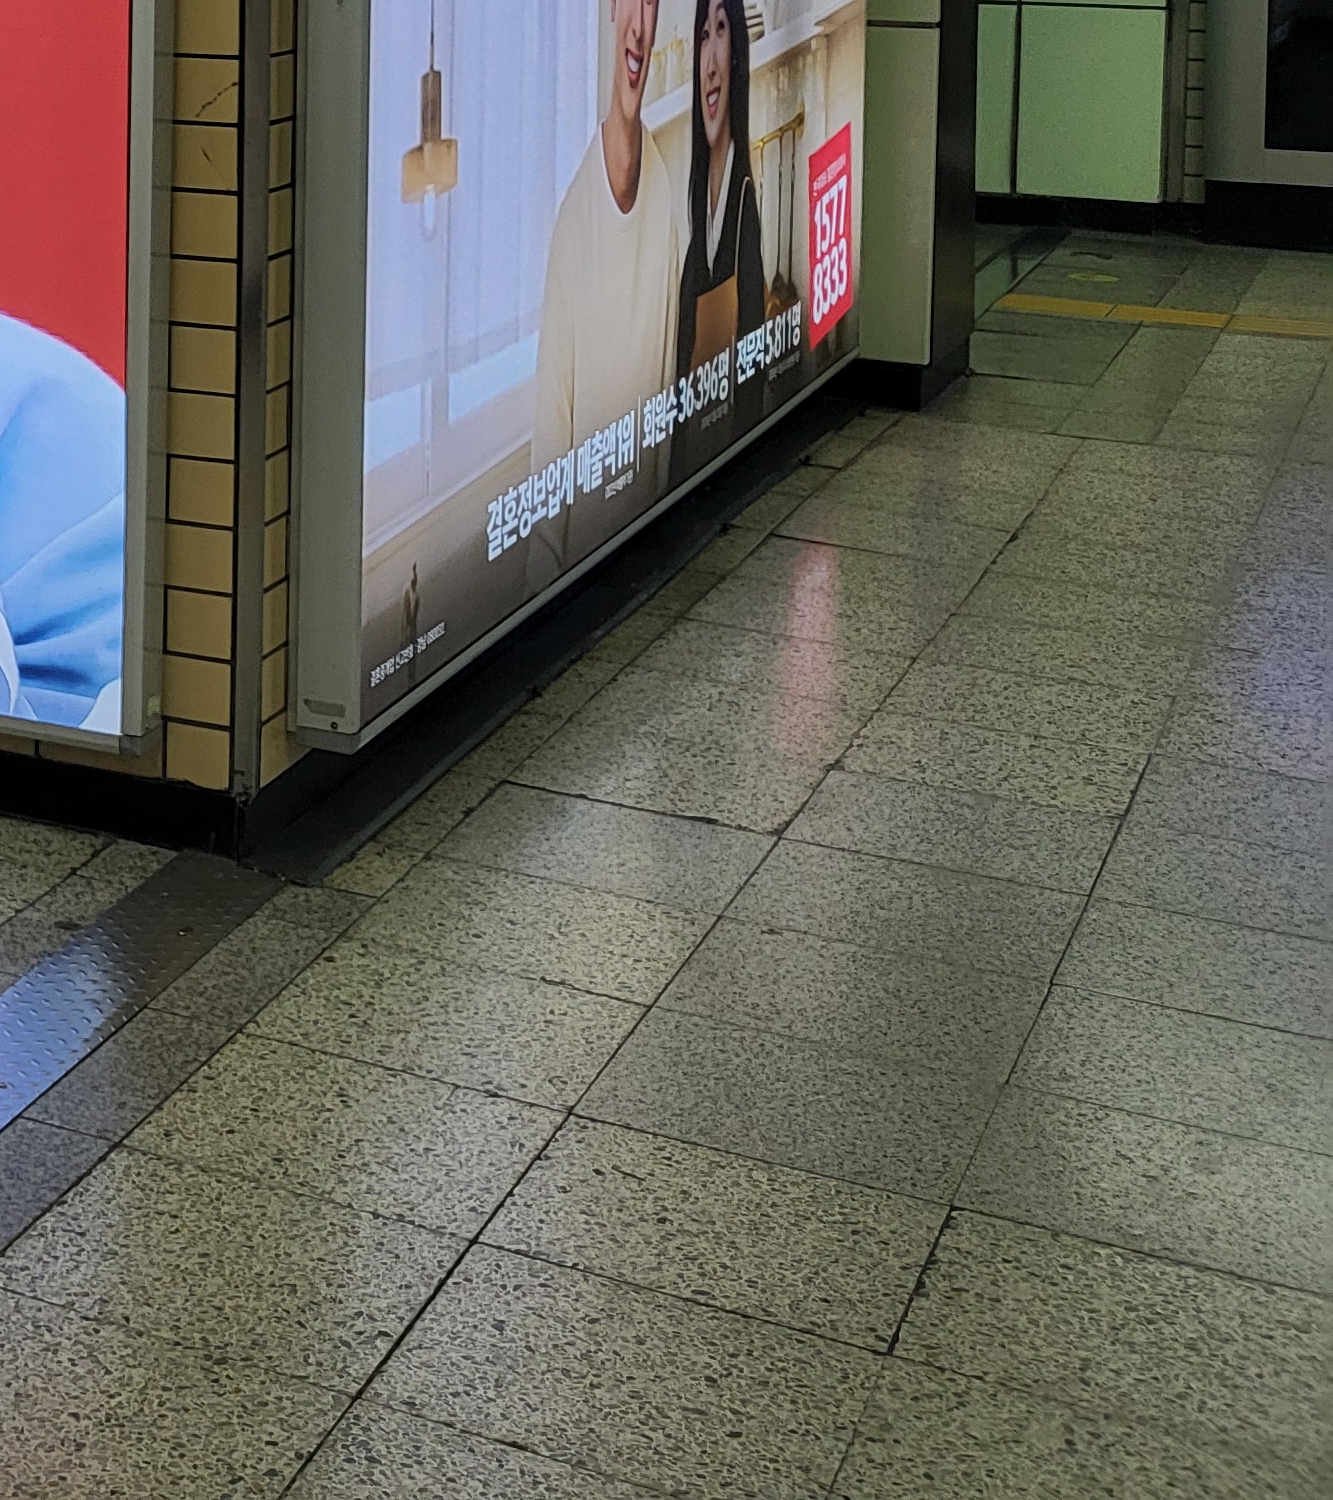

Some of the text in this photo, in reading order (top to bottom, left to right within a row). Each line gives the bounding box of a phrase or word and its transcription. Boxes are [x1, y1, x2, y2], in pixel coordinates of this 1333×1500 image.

[813, 174, 847, 260] 1577
[812, 237, 847, 325] 8333
[487, 449, 575, 563] 결혼정보업계
